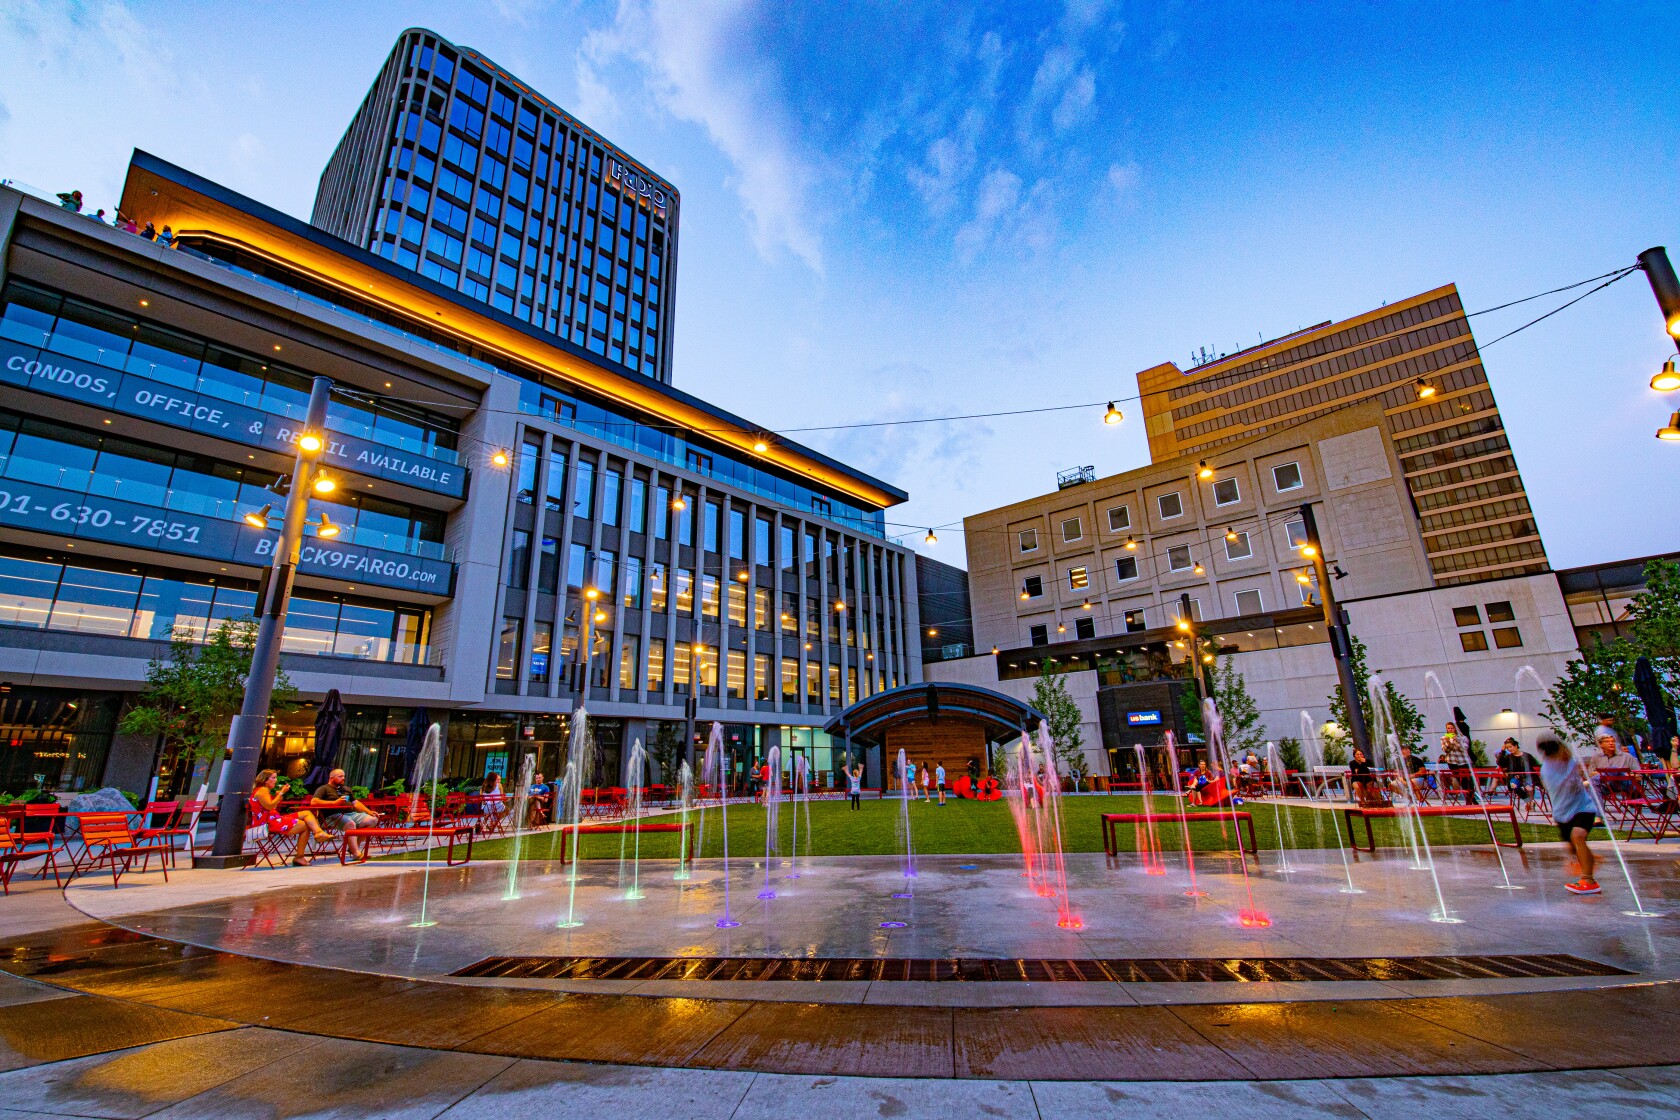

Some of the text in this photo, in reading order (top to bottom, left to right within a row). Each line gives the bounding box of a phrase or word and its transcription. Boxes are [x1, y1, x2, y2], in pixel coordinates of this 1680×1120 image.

[7, 355, 451, 484] CONDOS, OFFICE, & REIL AVAILABLE
[254, 538, 437, 584] BCK9FARGO.COM
